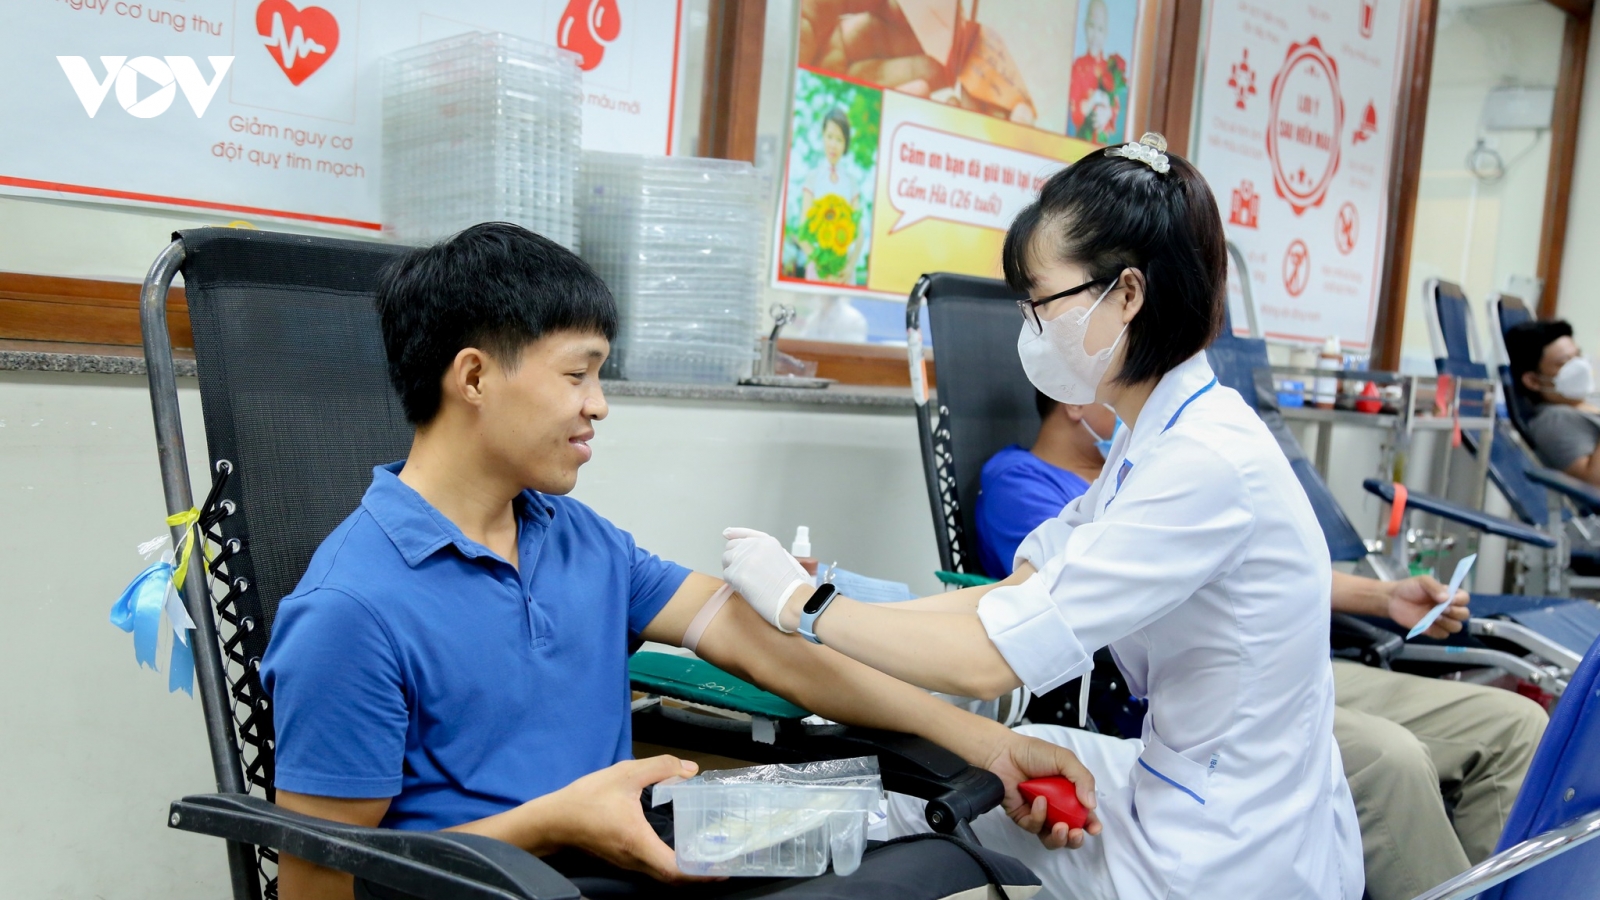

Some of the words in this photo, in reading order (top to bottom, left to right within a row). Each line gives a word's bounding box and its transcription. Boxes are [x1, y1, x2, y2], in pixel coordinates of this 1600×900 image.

[56, 0, 108, 15] guy
[115, 1, 142, 19] cơ
[148, 8, 185, 33] ung
[192, 14, 223, 36] thư
[229, 115, 279, 138] Giảm
[283, 127, 327, 149] nguy
[330, 135, 354, 150] cơ
[211, 141, 244, 162] đột
[286, 152, 312, 170] tim
[316, 159, 366, 178] mạch
[900, 142, 926, 166] Cảm
[945, 153, 965, 178] bạn
[929, 183, 948, 205] Hà
[950, 188, 971, 210] (26
